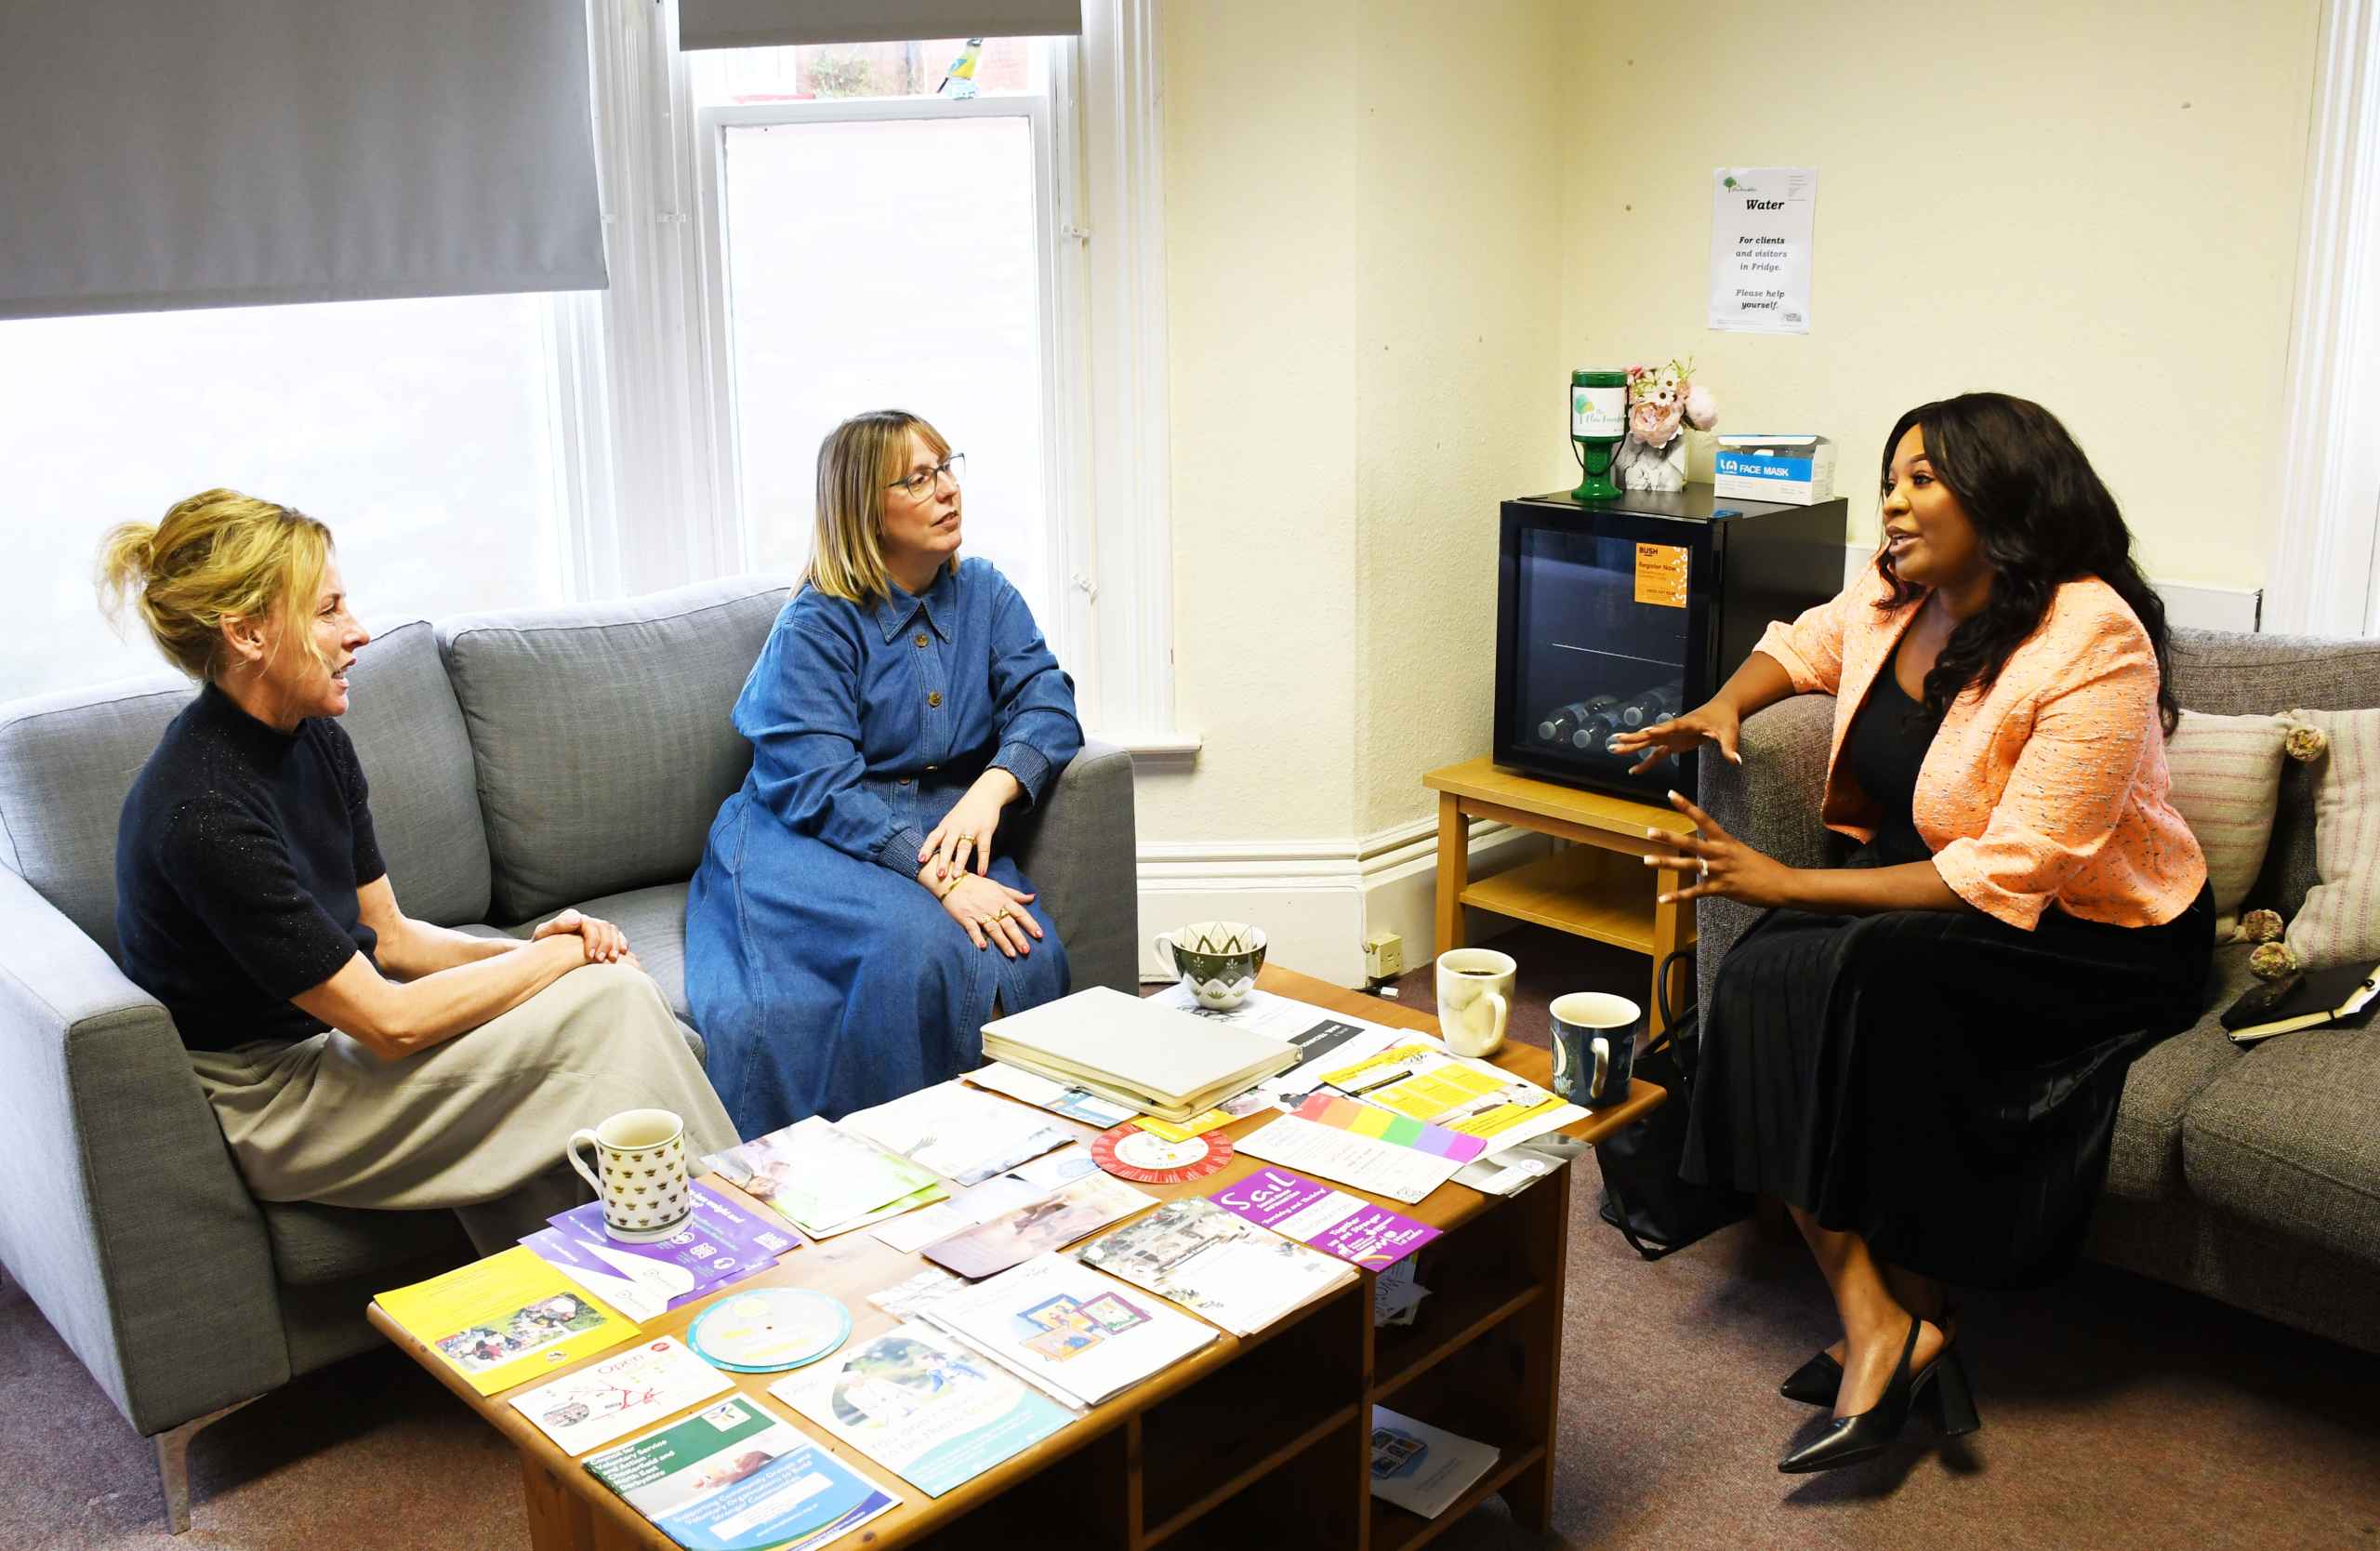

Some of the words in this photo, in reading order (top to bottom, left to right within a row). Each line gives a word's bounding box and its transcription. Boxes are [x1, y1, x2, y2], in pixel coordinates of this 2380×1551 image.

[1746, 199, 1784, 210] Water
[1739, 236, 1753, 245] For
[1755, 236, 1785, 245] clients
[1752, 263, 1781, 272] Fridge.
[1736, 289, 1763, 298] Please
[1766, 290, 1785, 299] help
[1740, 464, 1761, 475] FACE
[1764, 466, 1789, 477] MASK
[1221, 1172, 1296, 1211] Sail
[1329, 1216, 1360, 1236] Together
[595, 1452, 637, 1471] Voluntary
[636, 1439, 668, 1456] Service
[608, 1458, 659, 1480] Chesterfield
[659, 1450, 676, 1461] and
[619, 1456, 648, 1470] Action
[639, 1465, 660, 1476] East
